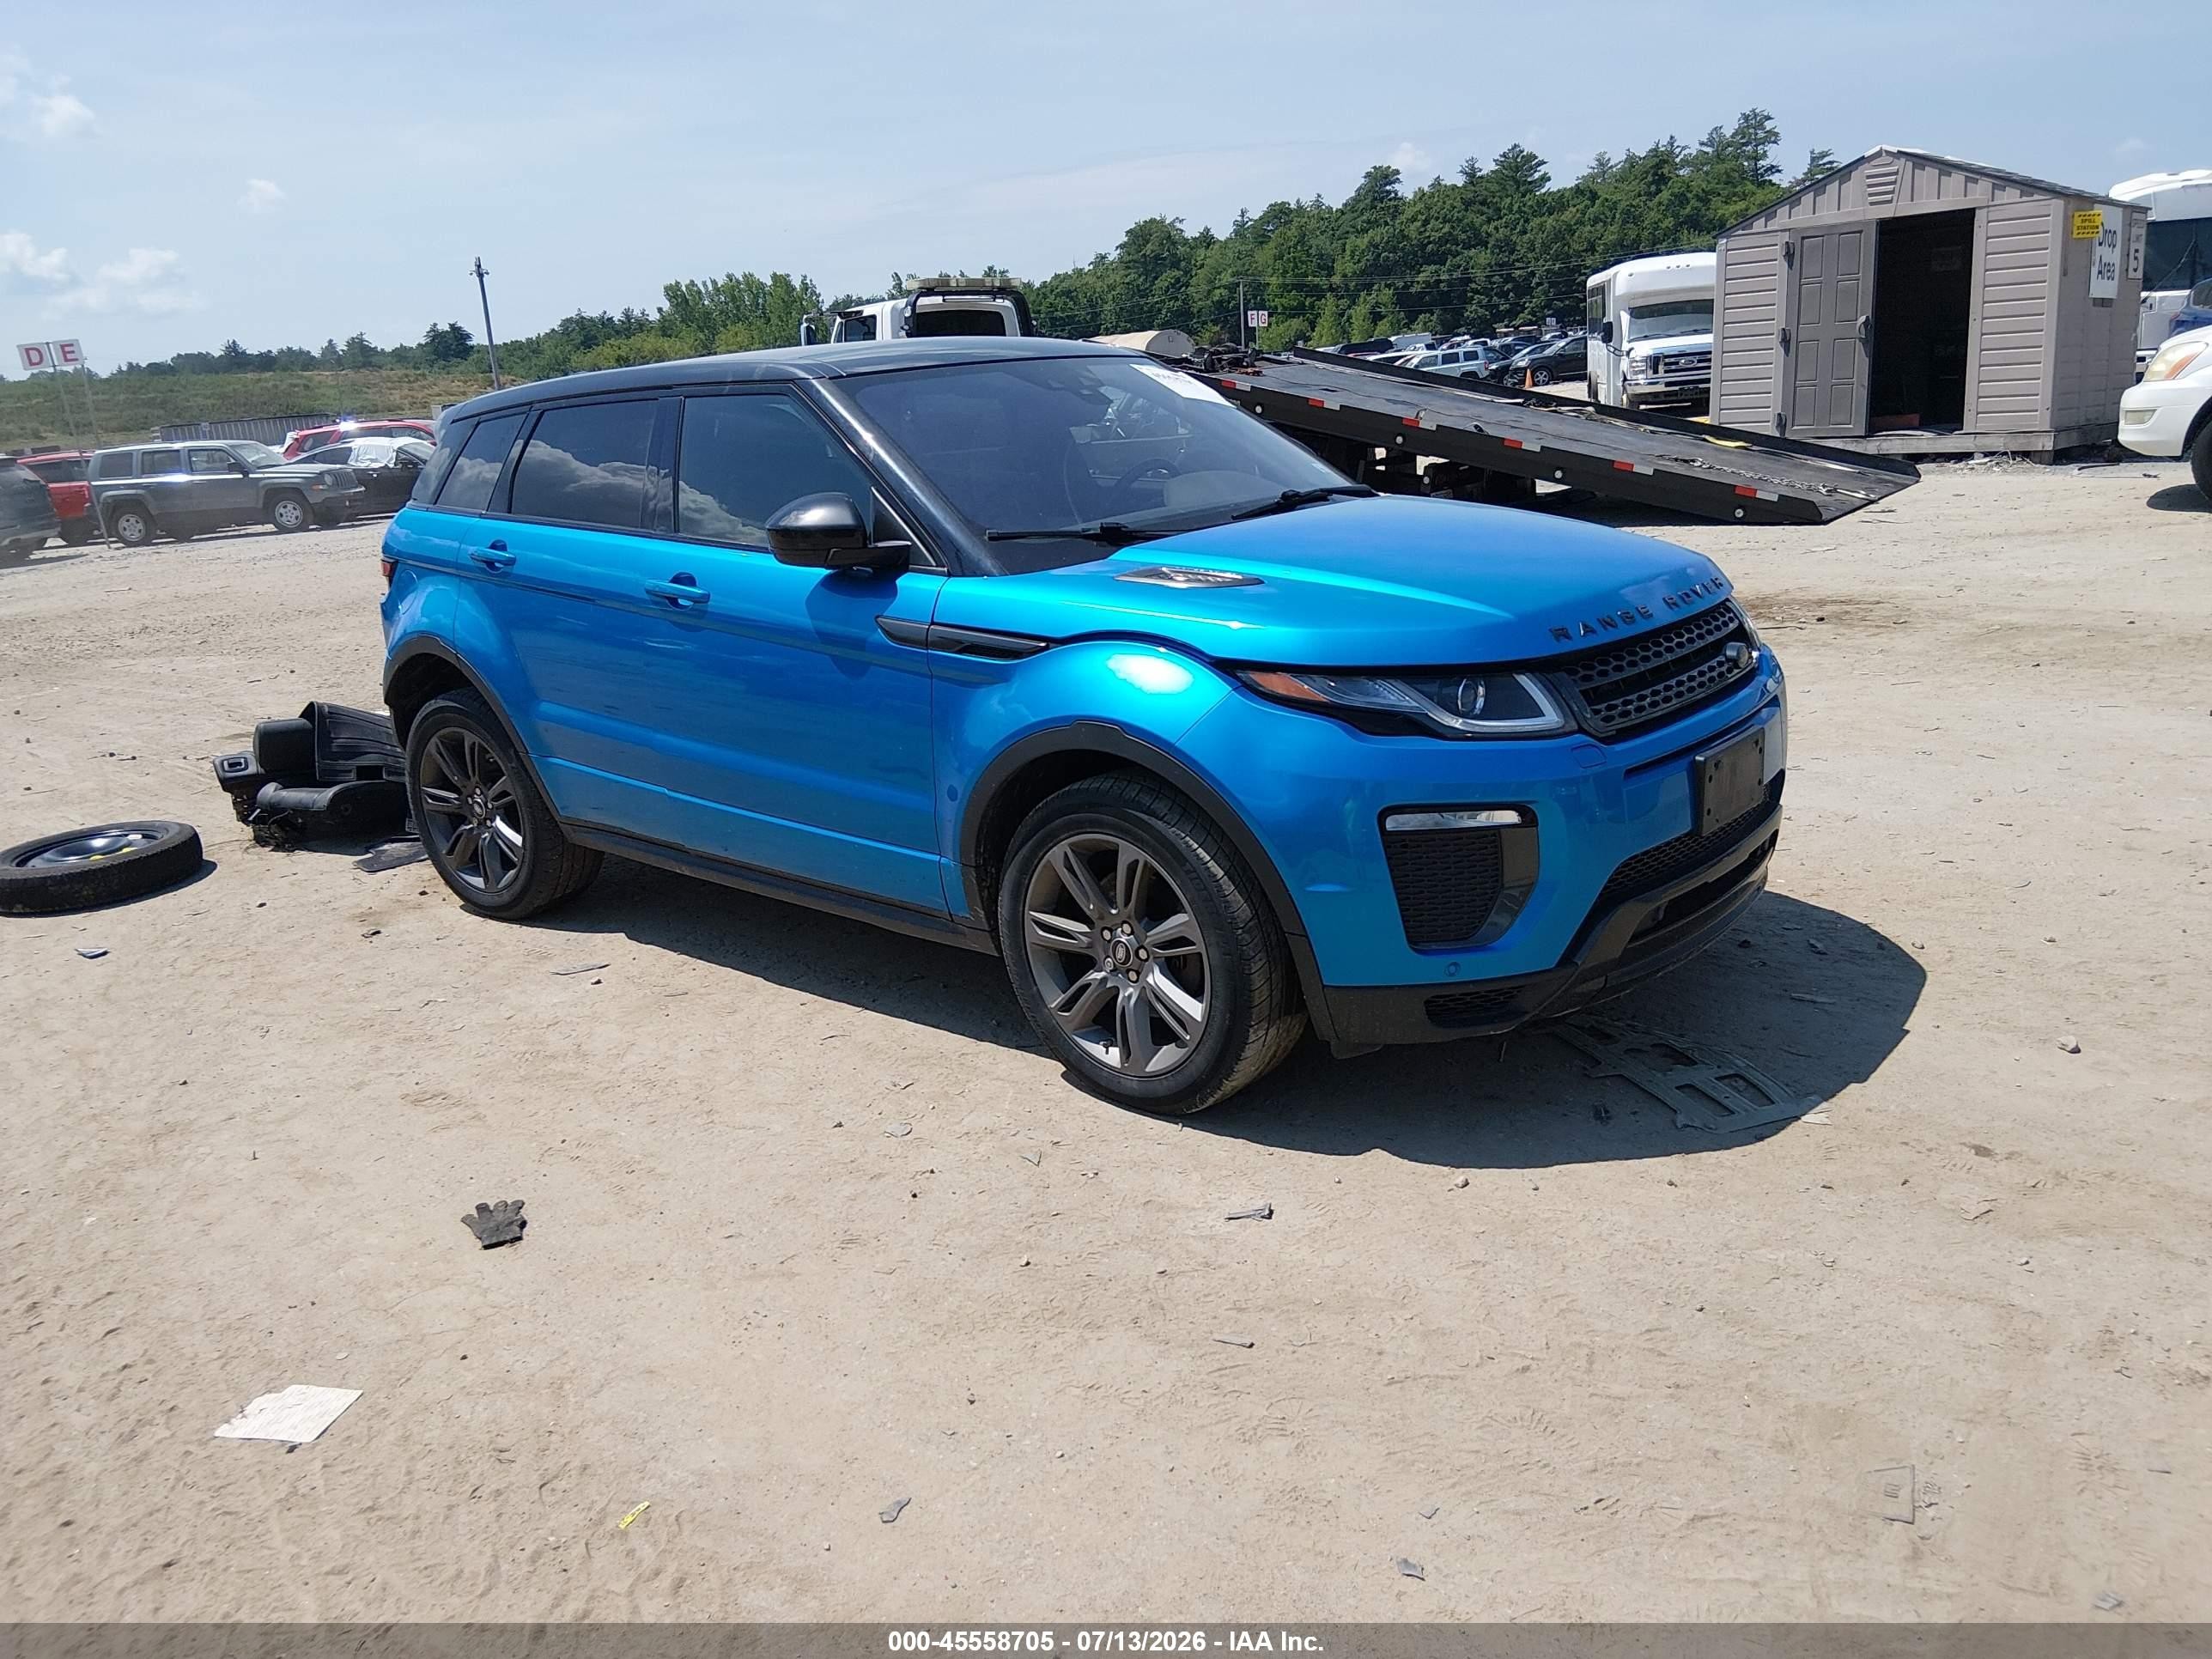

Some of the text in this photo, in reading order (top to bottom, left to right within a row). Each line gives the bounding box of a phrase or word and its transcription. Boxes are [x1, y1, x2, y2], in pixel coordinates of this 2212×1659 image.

[2098, 221, 2118, 254] Drop
[2096, 254, 2116, 282] Area
[2133, 248, 2140, 273] 5
[1250, 313, 1255, 325] F
[1261, 313, 1267, 325] G
[24, 347, 45, 367] D
[60, 343, 79, 362] E
[1549, 577, 1724, 642] RANGE ROVER
